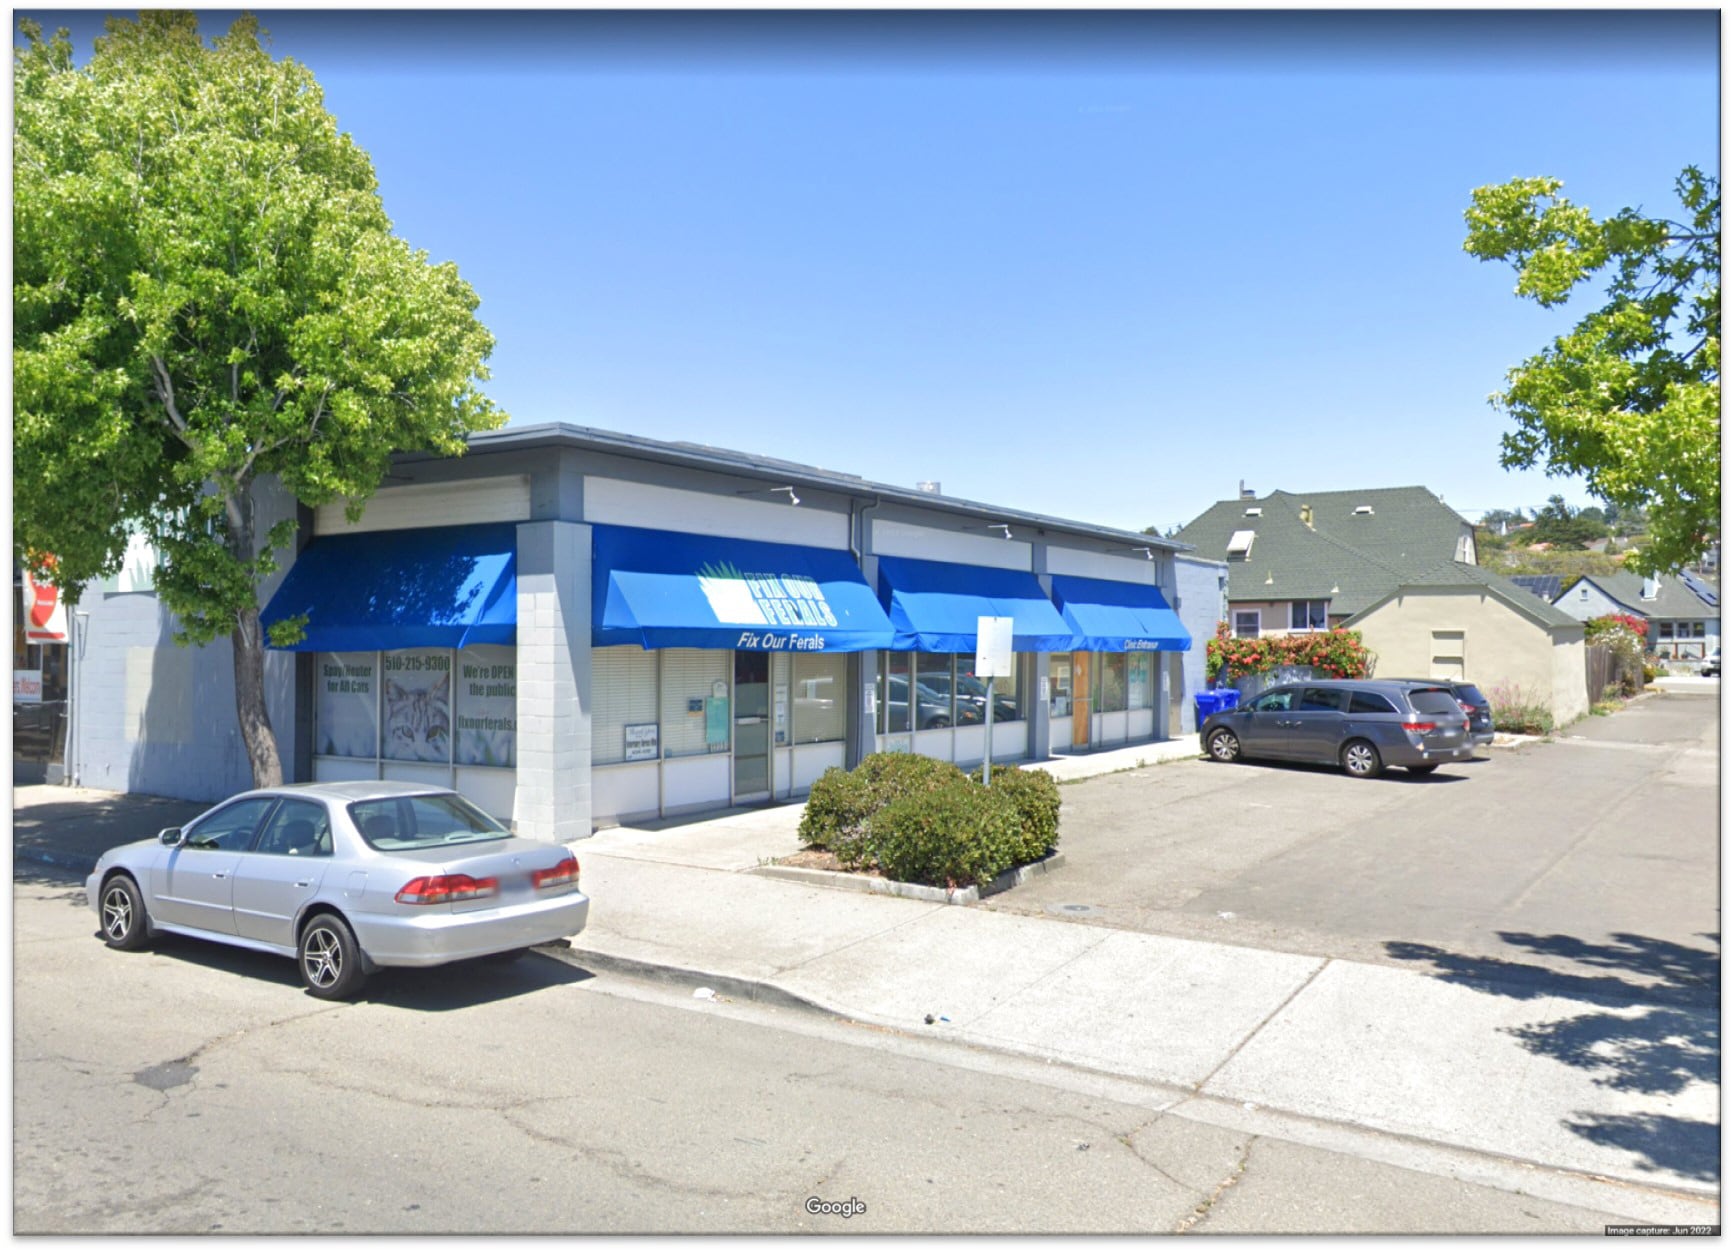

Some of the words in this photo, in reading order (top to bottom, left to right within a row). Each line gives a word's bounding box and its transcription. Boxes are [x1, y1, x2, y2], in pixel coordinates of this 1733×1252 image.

[744, 573, 788, 599] FIX
[781, 573, 825, 601] OUR
[757, 599, 839, 627] FERALS
[737, 632, 760, 648] Fix
[762, 633, 787, 649] Our
[789, 633, 825, 650] Ferals
[385, 655, 450, 671] 510-215-9300
[463, 664, 490, 679] We're
[491, 665, 514, 679] OPEN
[327, 680, 338, 692] for
[351, 680, 370, 693] Cats
[469, 682, 485, 696] the
[486, 683, 517, 698] public
